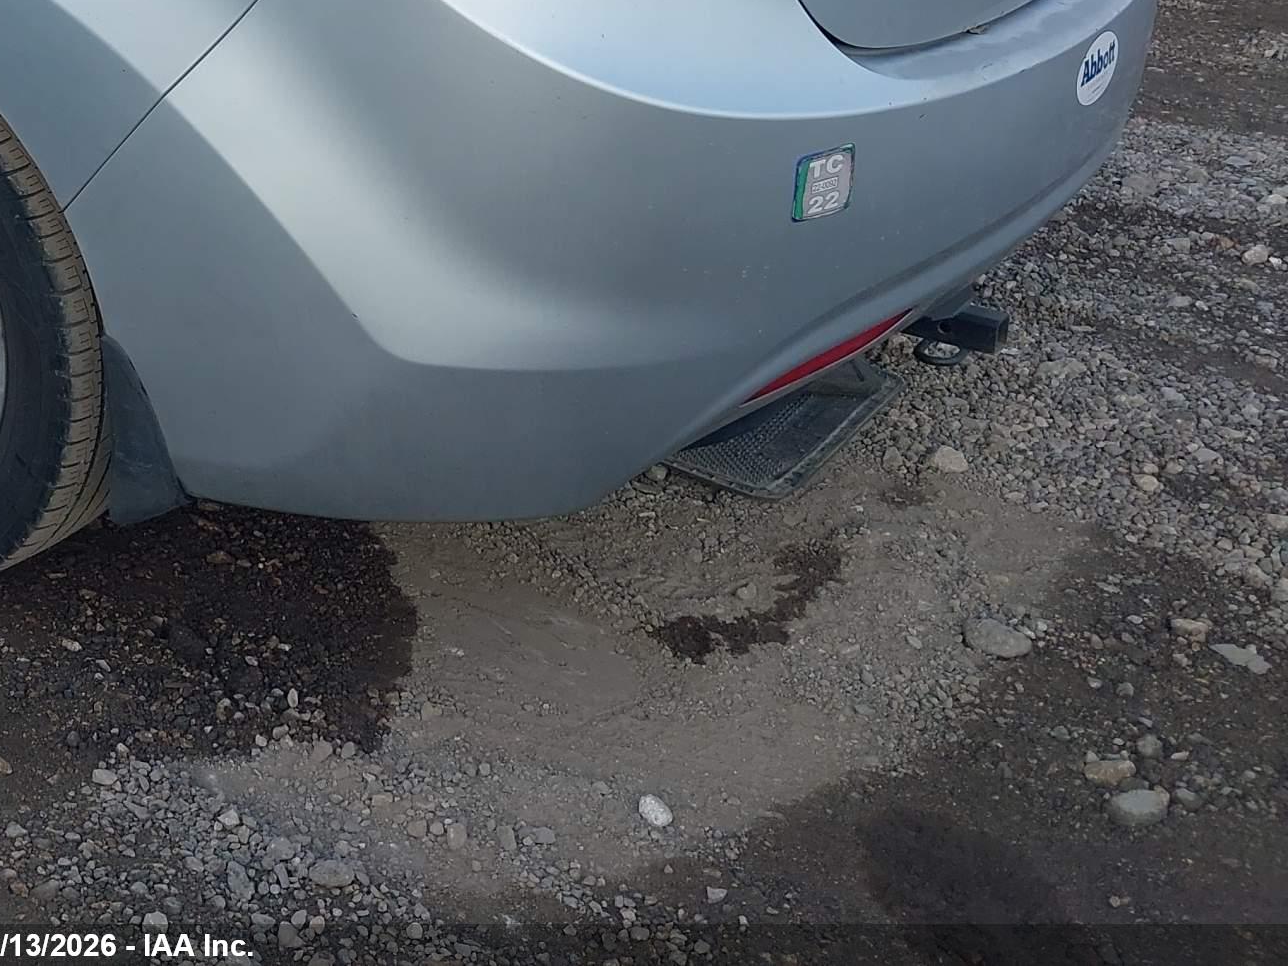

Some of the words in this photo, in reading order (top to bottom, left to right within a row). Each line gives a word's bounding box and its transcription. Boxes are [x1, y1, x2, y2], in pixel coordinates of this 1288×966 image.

[1080, 39, 1116, 87] Abbott
[809, 154, 843, 178] TC
[807, 190, 839, 214] 22
